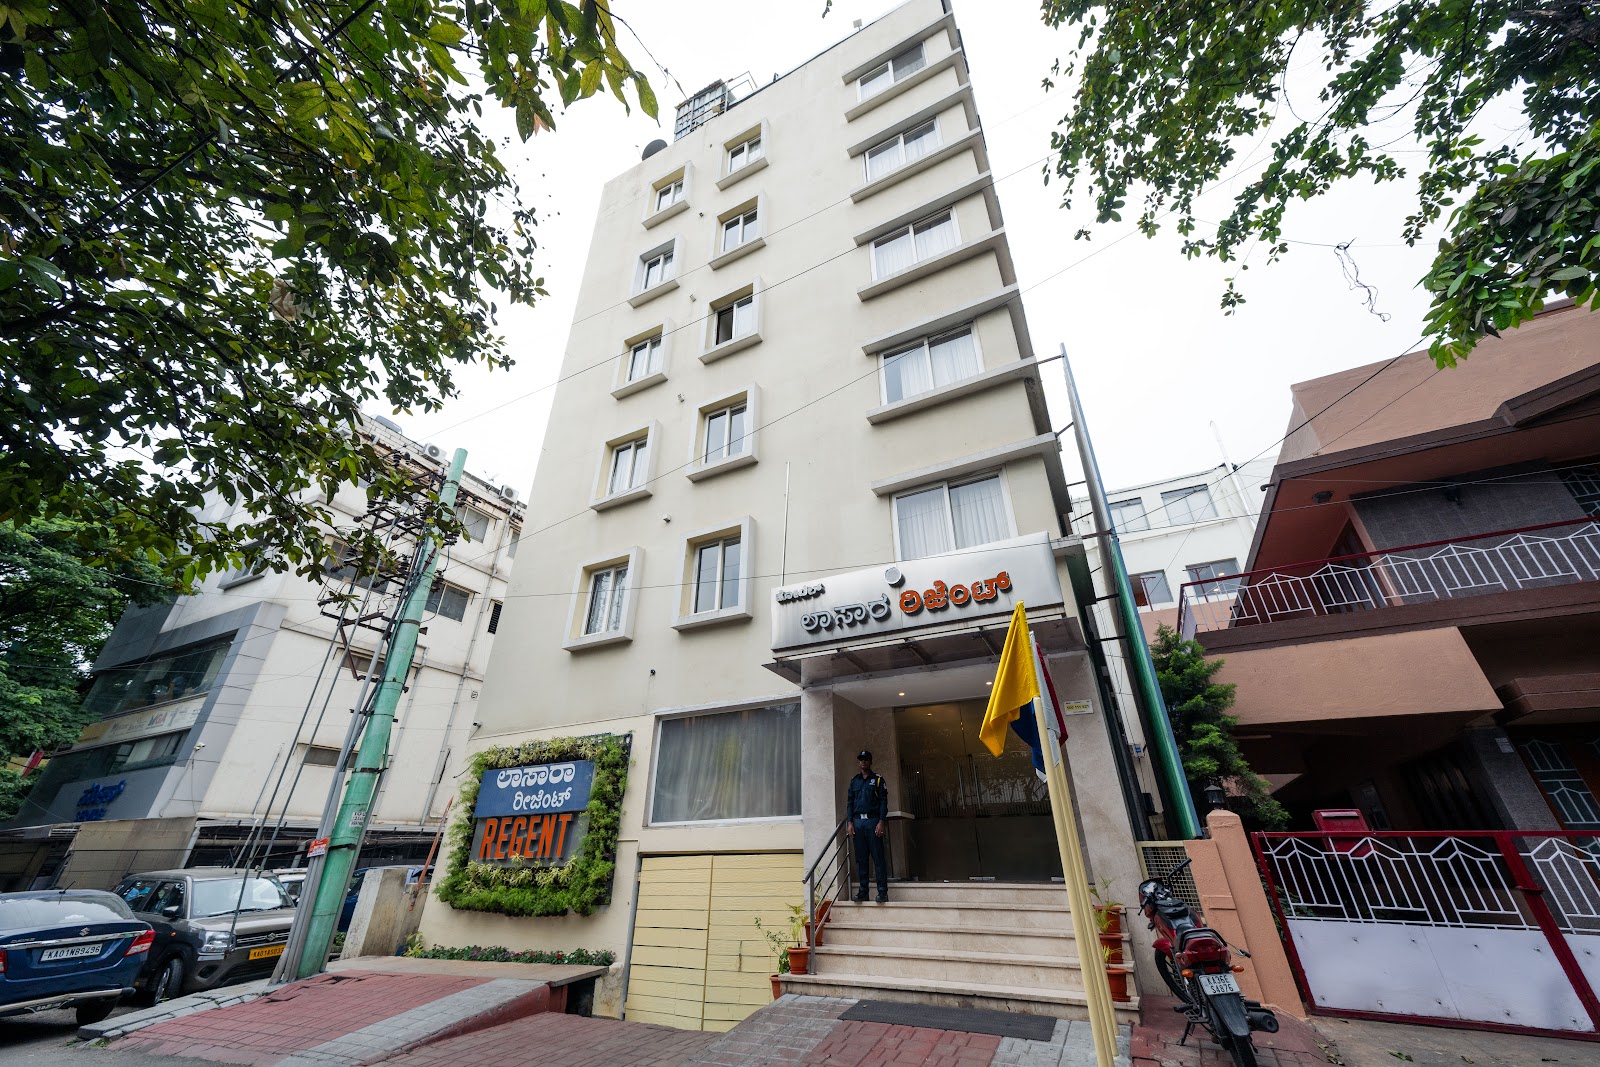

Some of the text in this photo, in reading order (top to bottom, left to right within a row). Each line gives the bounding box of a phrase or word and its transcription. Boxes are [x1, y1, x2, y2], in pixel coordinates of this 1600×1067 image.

[900, 571, 1011, 613] ರಿಜೆಂಟ್
[496, 763, 576, 789] ಲಾಸಾರಾ
[512, 787, 573, 811] ರೀಜೆಂಟ್
[479, 814, 572, 859] REGENT
[1206, 975, 1230, 985] KA36E
[1210, 984, 1234, 993] S4876
